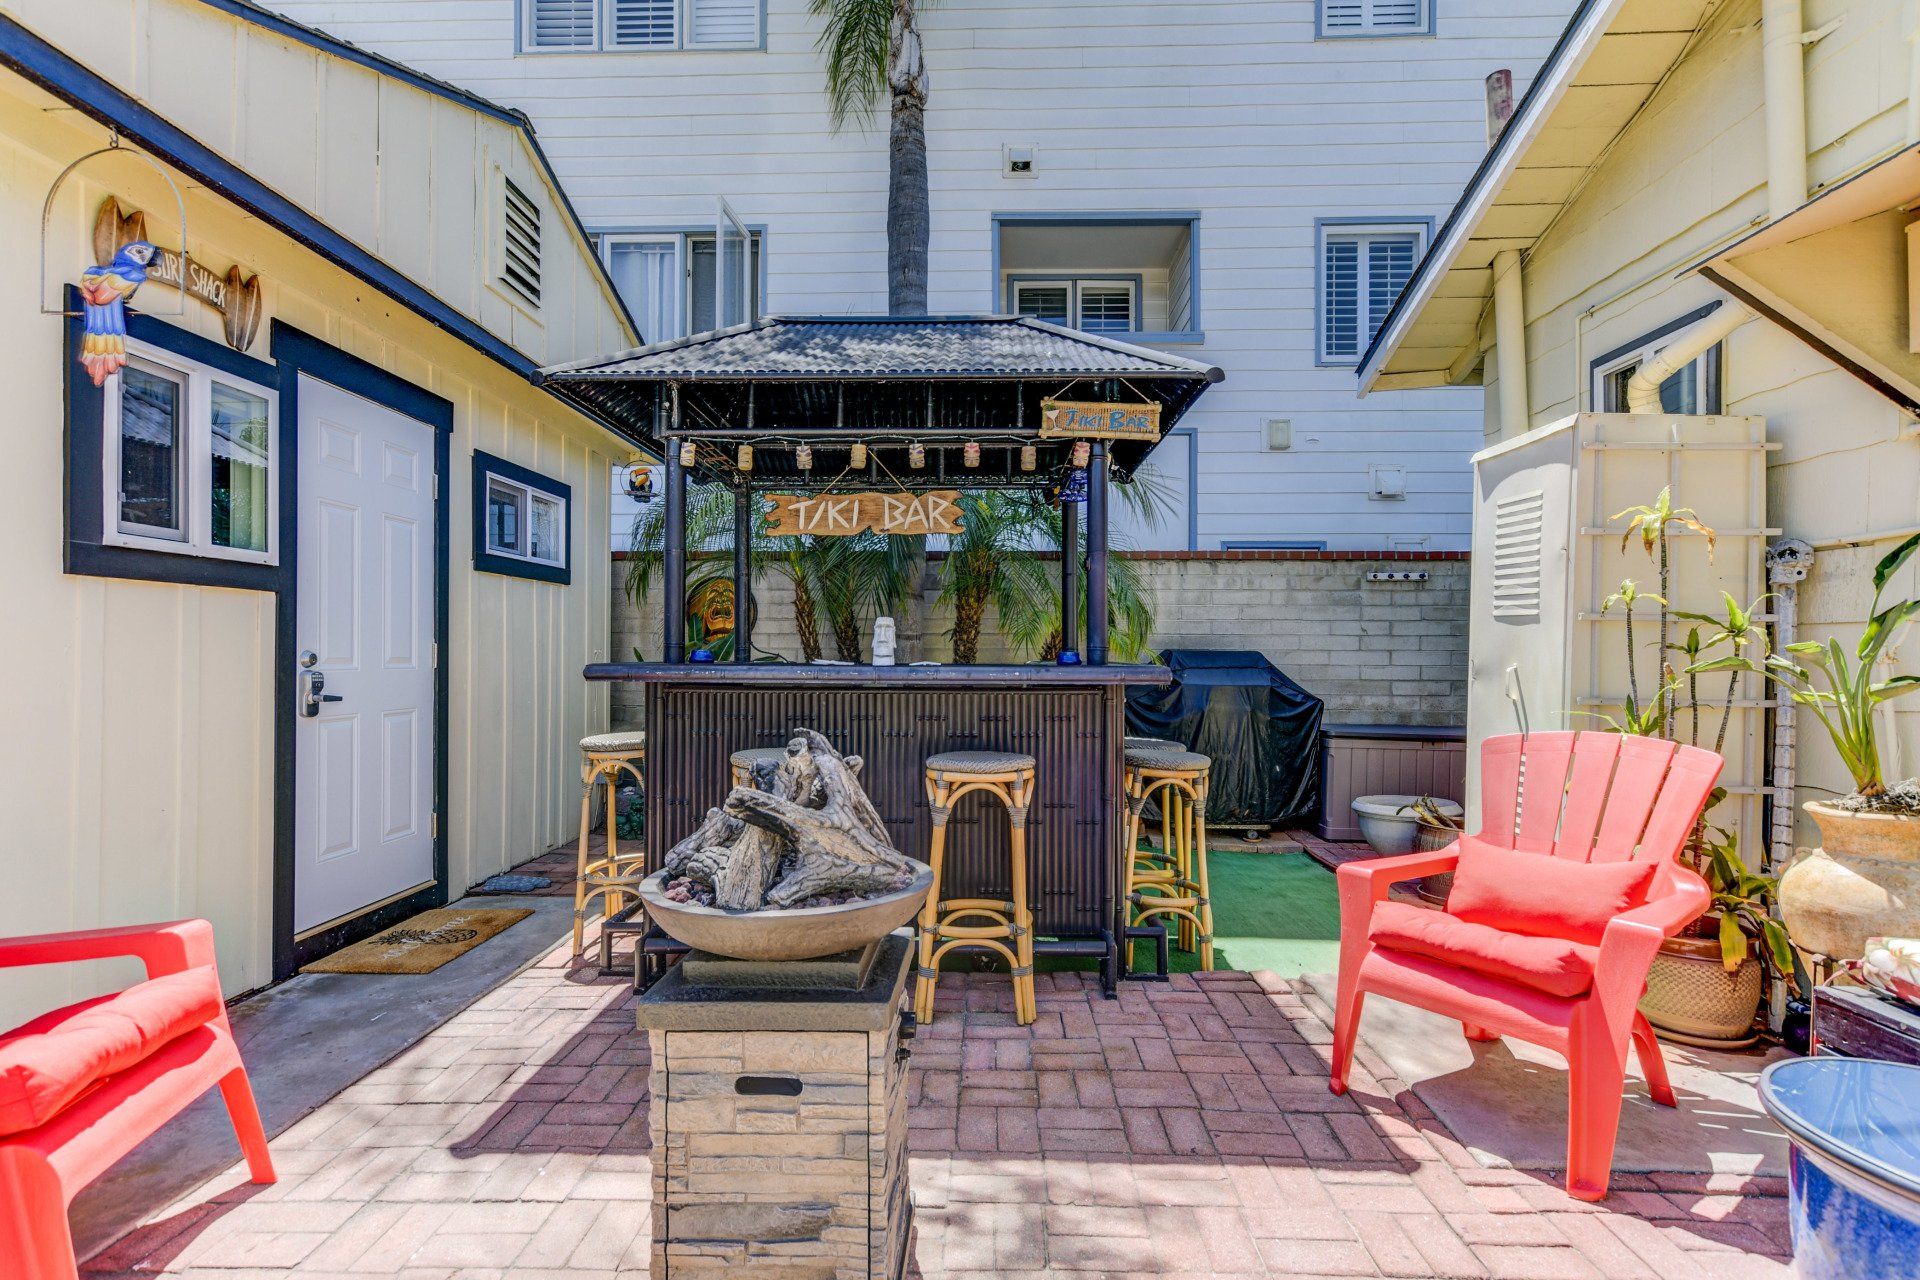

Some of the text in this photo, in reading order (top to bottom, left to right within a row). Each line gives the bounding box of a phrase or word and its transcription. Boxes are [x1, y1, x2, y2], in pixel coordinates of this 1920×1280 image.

[190, 263, 227, 308] SHACK
[787, 496, 951, 531] TIKI BAR
